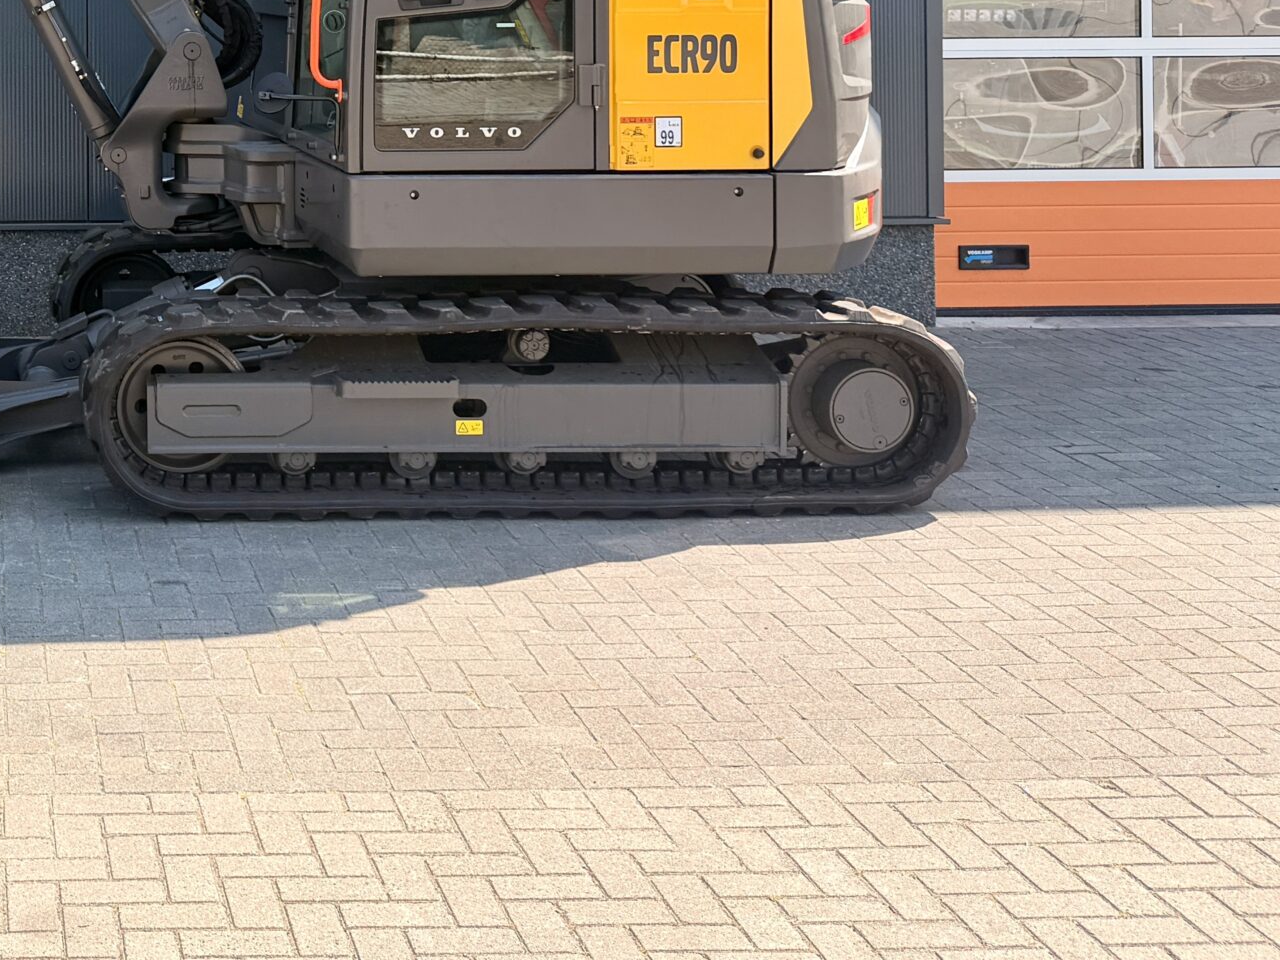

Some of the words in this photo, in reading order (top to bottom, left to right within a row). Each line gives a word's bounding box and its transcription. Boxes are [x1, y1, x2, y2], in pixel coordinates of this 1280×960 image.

[647, 34, 738, 74] ECR90
[401, 126, 522, 139] VOLVO
[660, 129, 675, 145] 99
